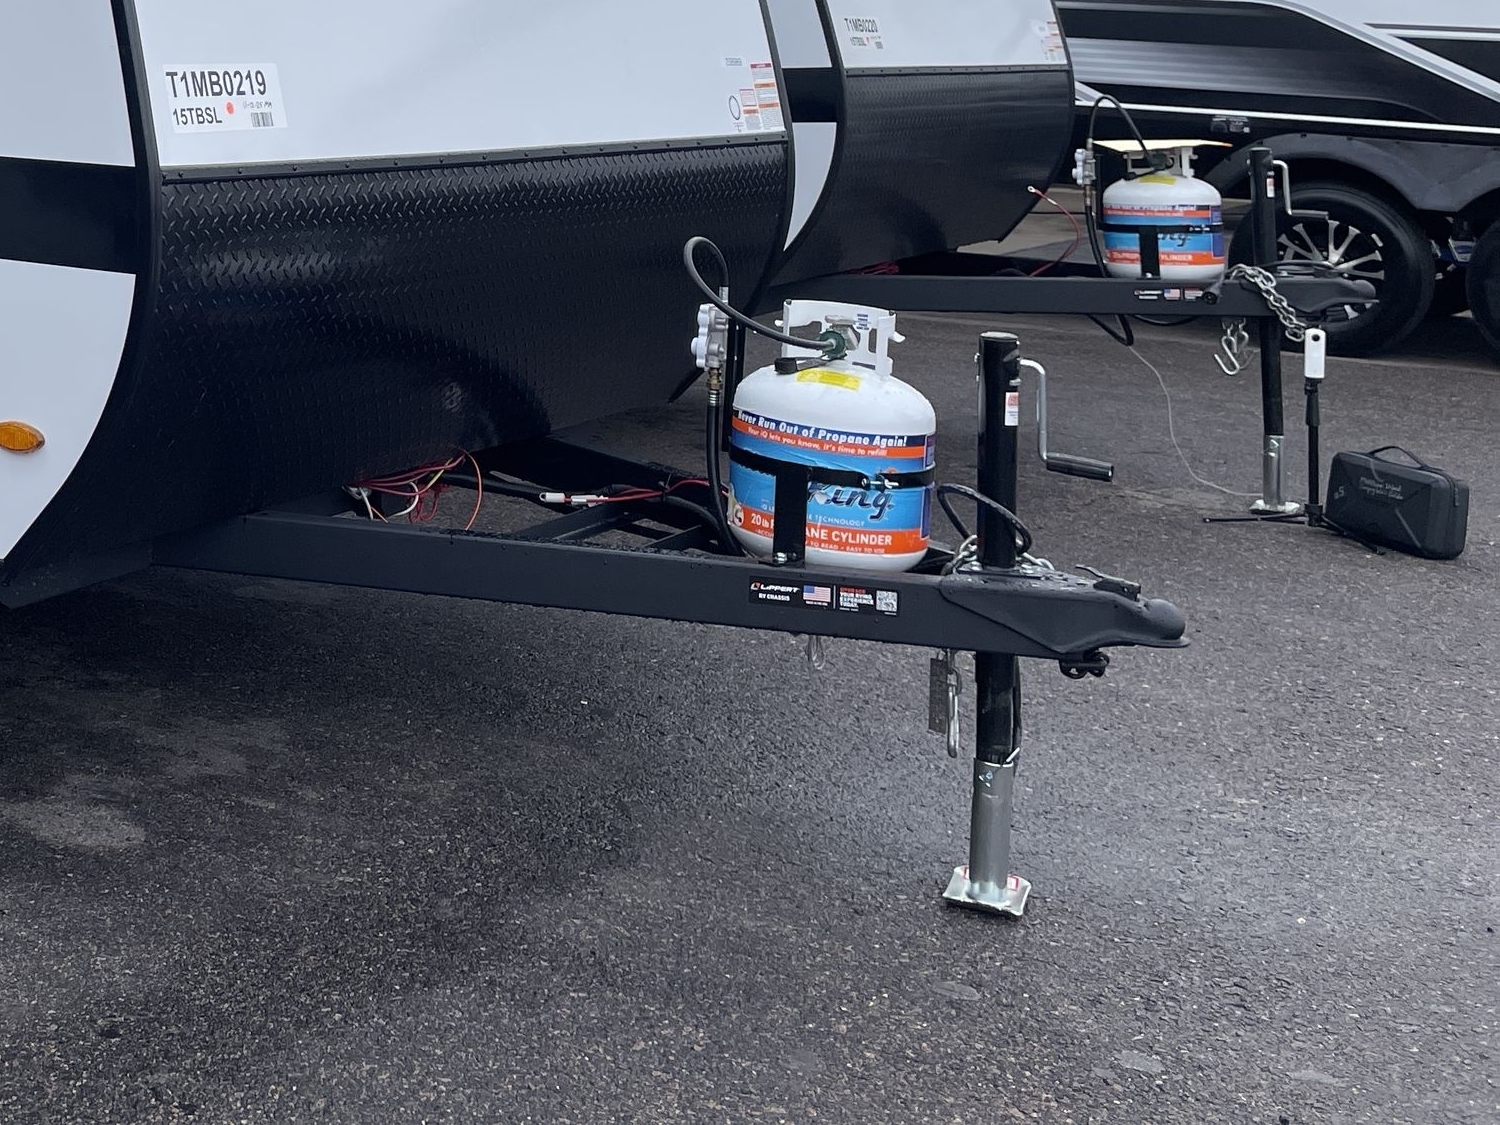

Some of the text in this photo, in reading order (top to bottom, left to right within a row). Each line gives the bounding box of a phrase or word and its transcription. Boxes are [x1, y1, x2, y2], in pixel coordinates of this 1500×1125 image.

[165, 69, 267, 98] T1MB0219
[172, 106, 223, 126] 15TBSL
[758, 416, 776, 430] Run
[779, 422, 799, 435] Out
[802, 427, 816, 438] of
[817, 429, 870, 445] Propane
[872, 435, 908, 448] Again!
[782, 437, 796, 445] you
[838, 445, 856, 454] time
[857, 447, 866, 455] to
[751, 513, 762, 526] 20
[831, 530, 893, 546] CYLINDER
[815, 514, 866, 527] TECHNOLOGY
[767, 594, 791, 602] CHASSIS
